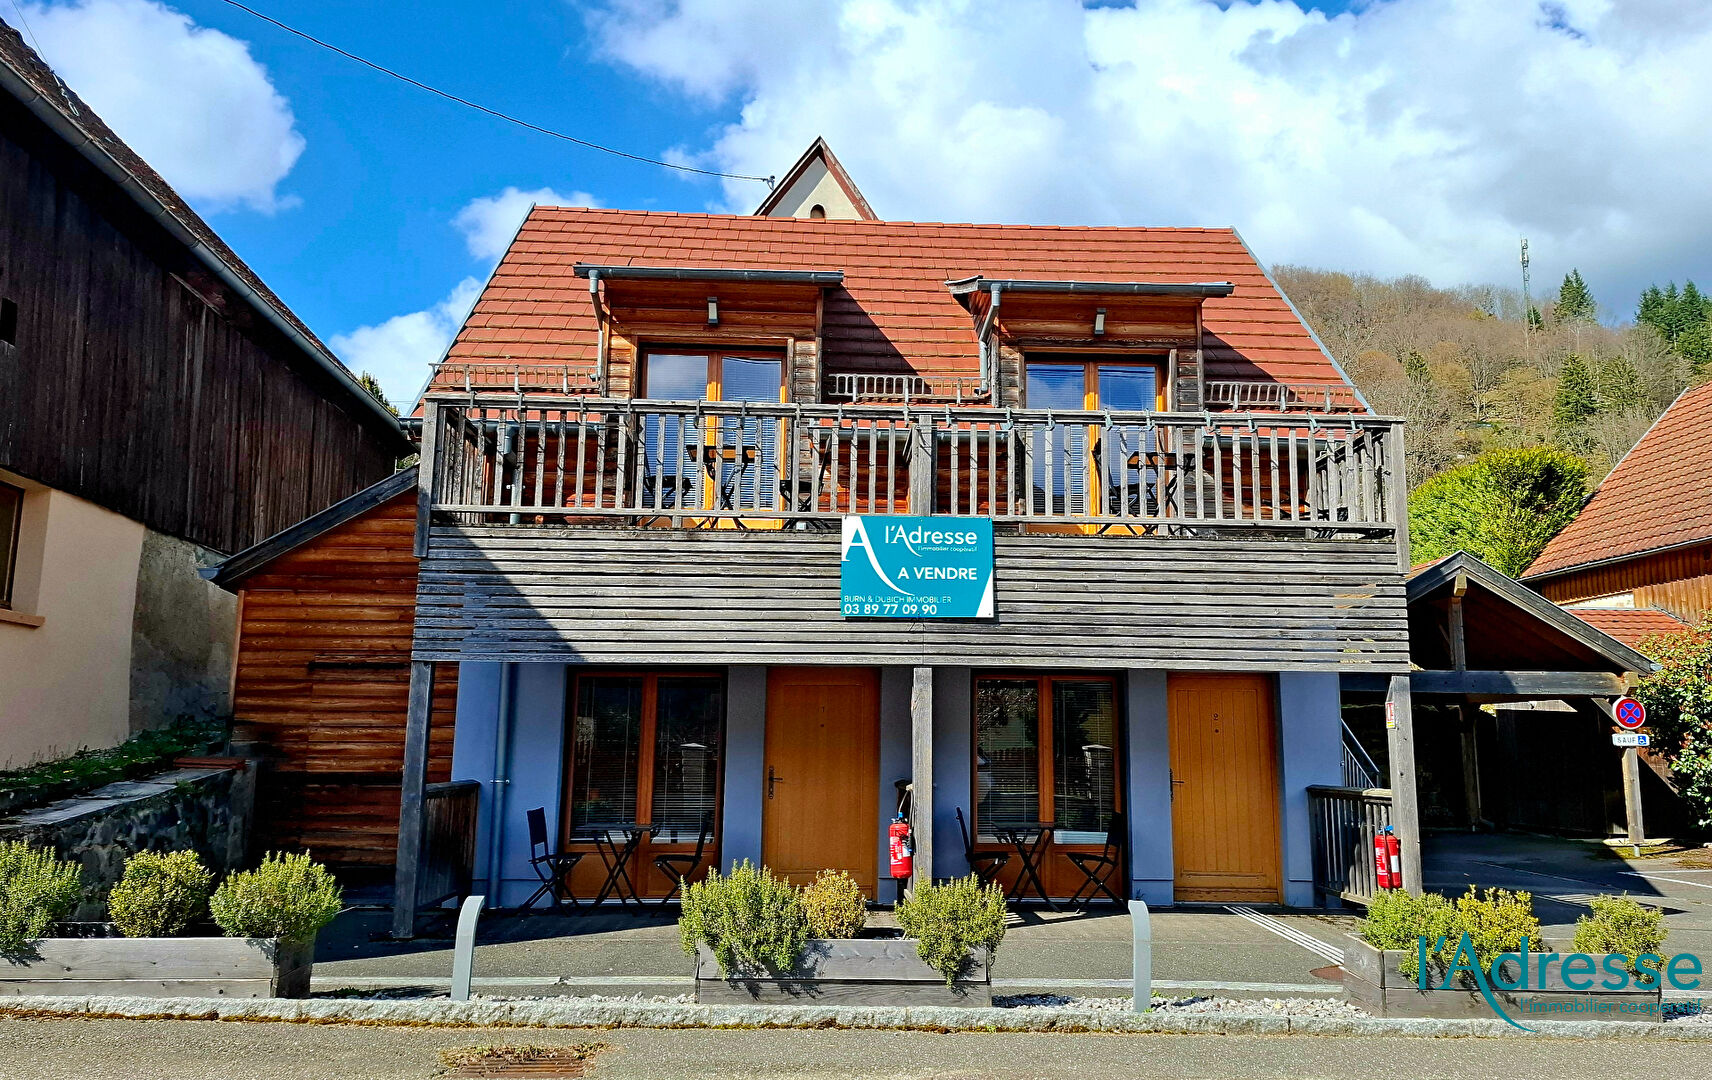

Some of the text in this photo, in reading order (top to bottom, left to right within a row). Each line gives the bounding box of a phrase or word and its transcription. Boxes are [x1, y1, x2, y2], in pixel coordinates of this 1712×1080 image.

[885, 524, 978, 557] l'Adresse
[897, 567, 978, 580] A VENDRE
[844, 595, 952, 604] BURN & DUBICH IMMOBILIER
[844, 604, 938, 615] 03 89 77 09 90
[1617, 736, 1636, 744] SAUF
